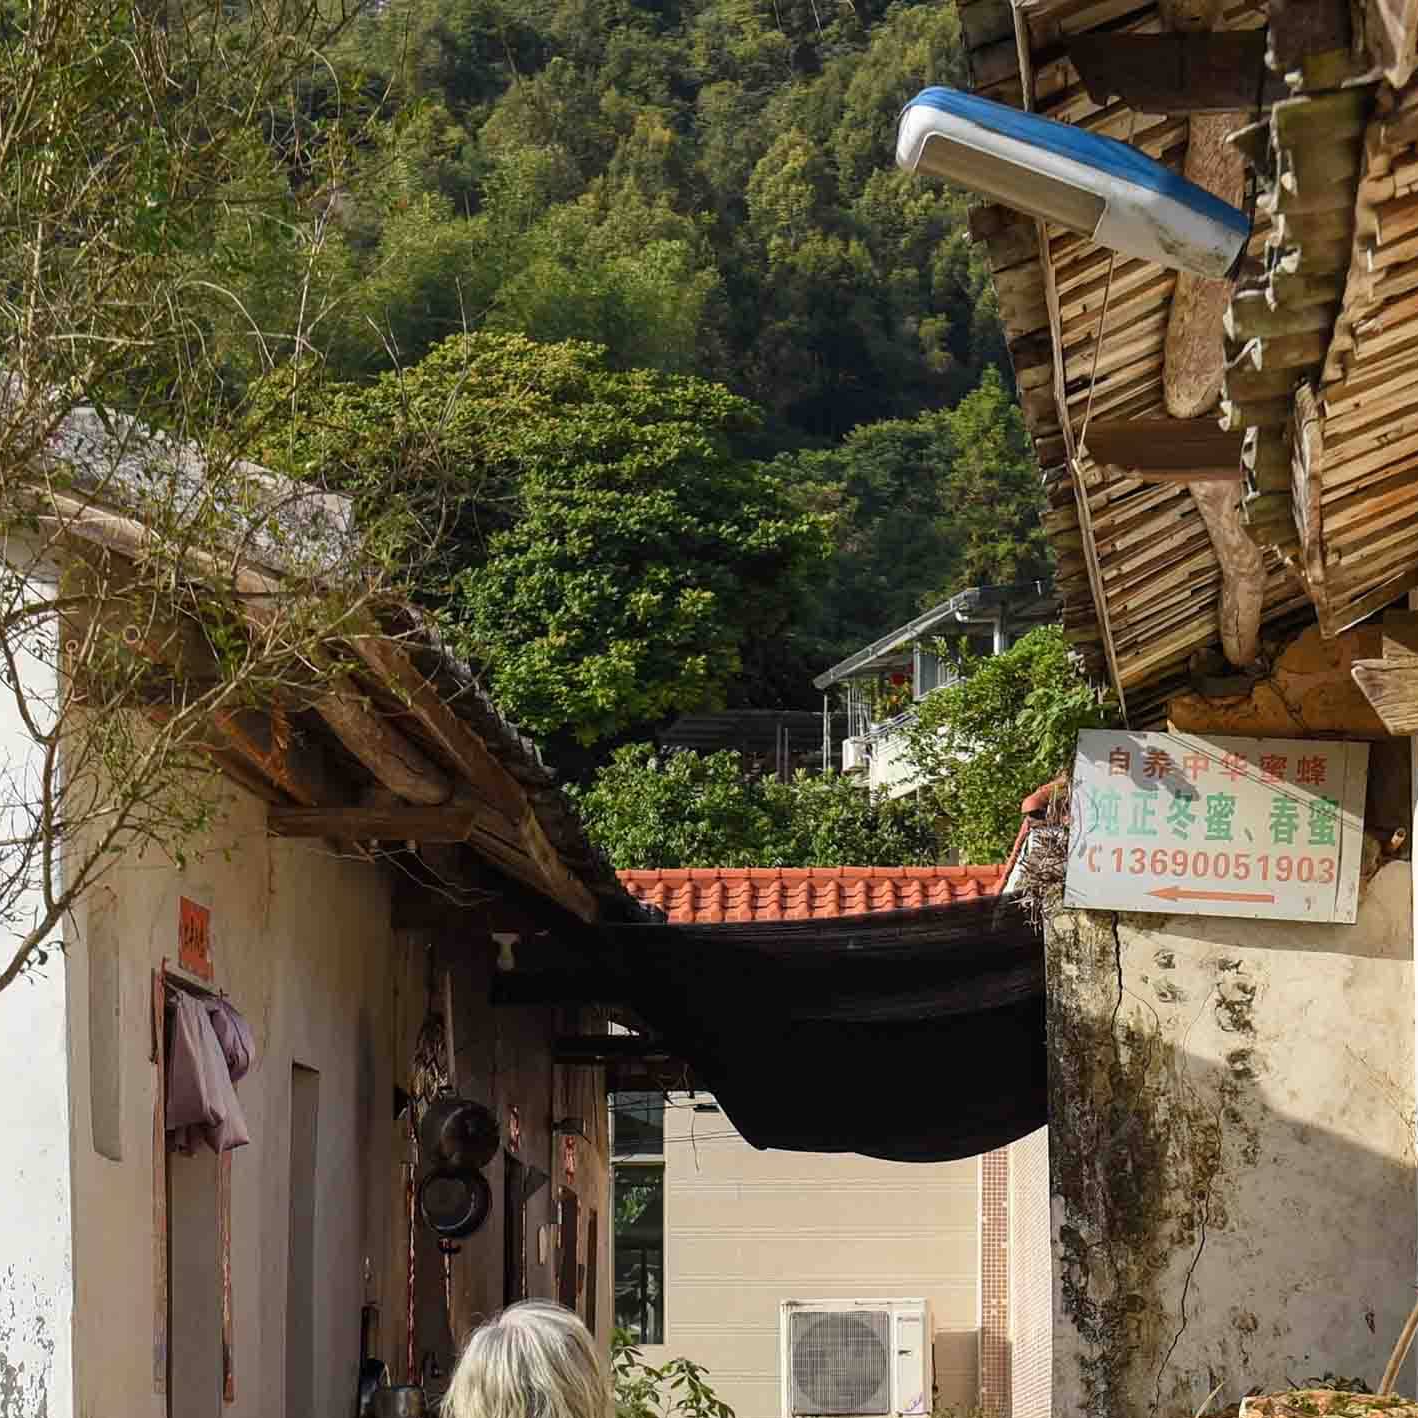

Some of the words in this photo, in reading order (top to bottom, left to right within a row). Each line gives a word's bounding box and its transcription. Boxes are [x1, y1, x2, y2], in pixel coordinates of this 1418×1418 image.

[1109, 747, 1329, 784] 自养中华蜜蜂
[1111, 847, 1336, 884] 13690051903
